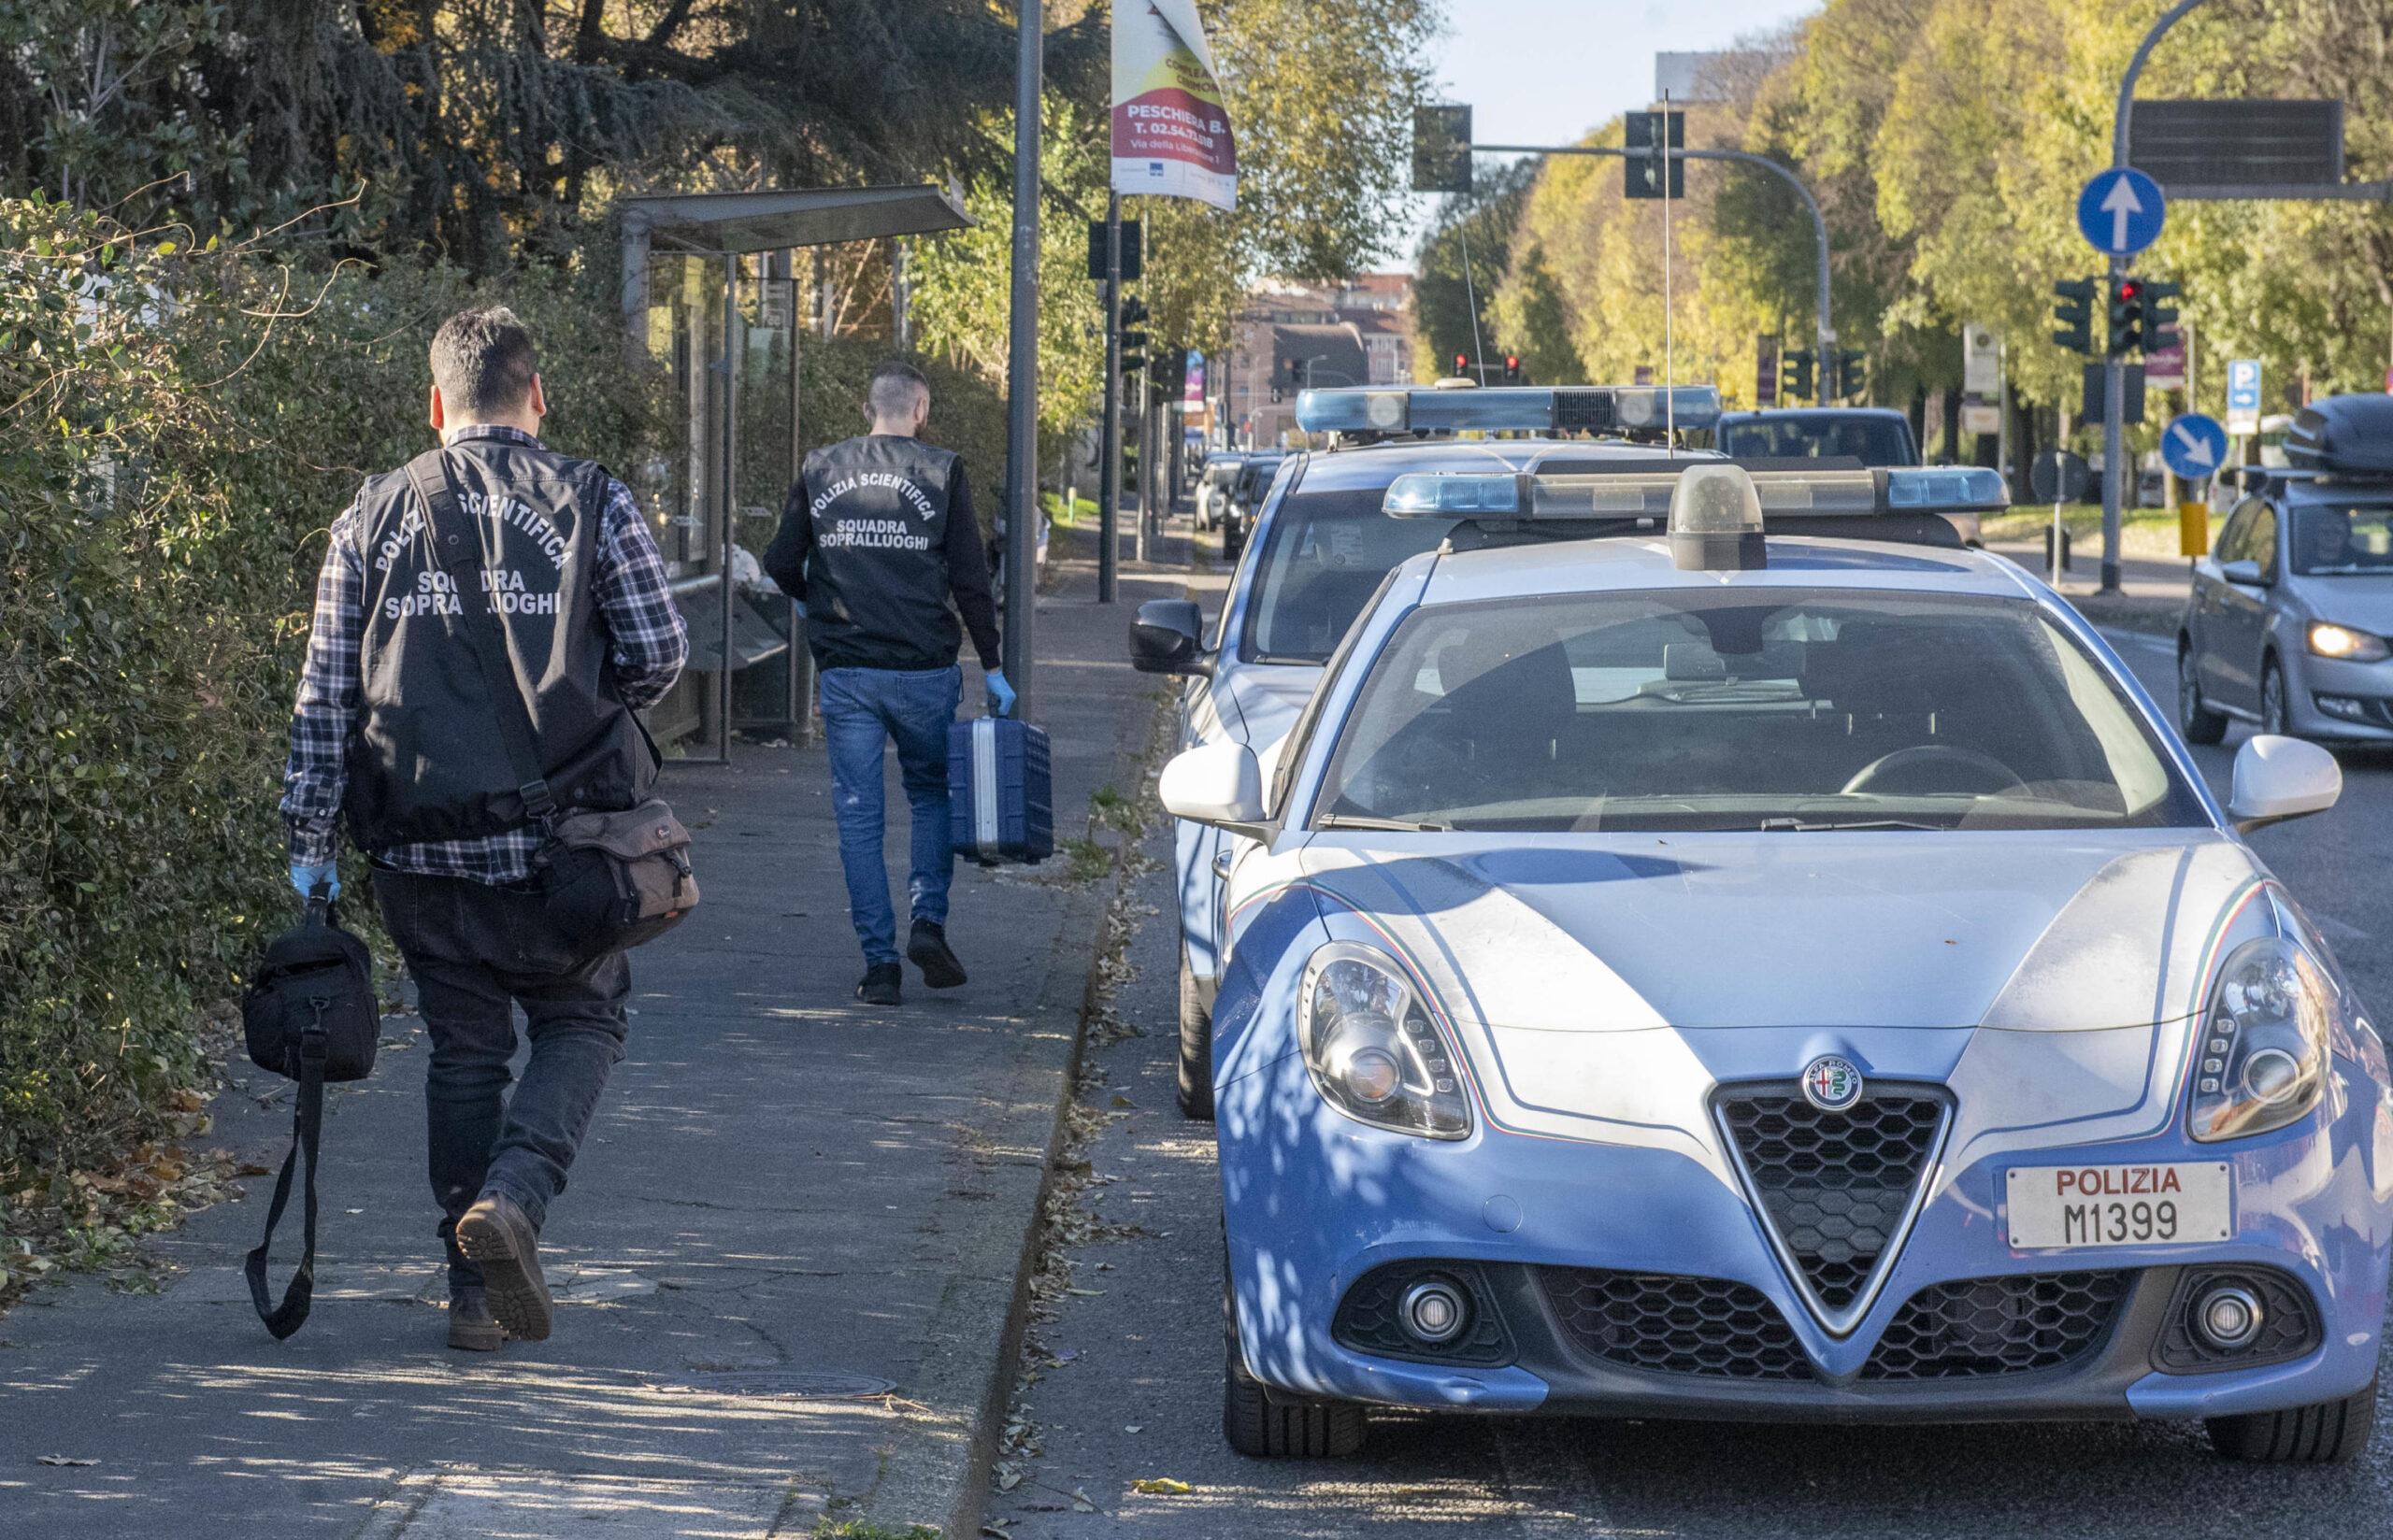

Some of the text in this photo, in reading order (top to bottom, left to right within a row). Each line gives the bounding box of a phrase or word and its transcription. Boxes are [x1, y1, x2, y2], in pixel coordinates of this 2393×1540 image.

[1127, 105, 1225, 134] PESCHIERA B.
[1135, 122, 1147, 134] T.
[1129, 139, 1148, 149] Via
[1150, 138, 1174, 150] della
[810, 473, 936, 521] POLIZIA SCIENTIFICA
[375, 508, 427, 572] POLIZ
[837, 520, 908, 535] SQUADRA
[819, 534, 928, 550] SOPRALLUOGHI
[417, 570, 525, 592] SQDRA
[385, 592, 561, 620] SOPRAUOGHI
[1828, 1060, 1857, 1084] ROMEO
[2056, 1167, 2182, 1196] POLIZIA
[2064, 1200, 2178, 1244] M1399
